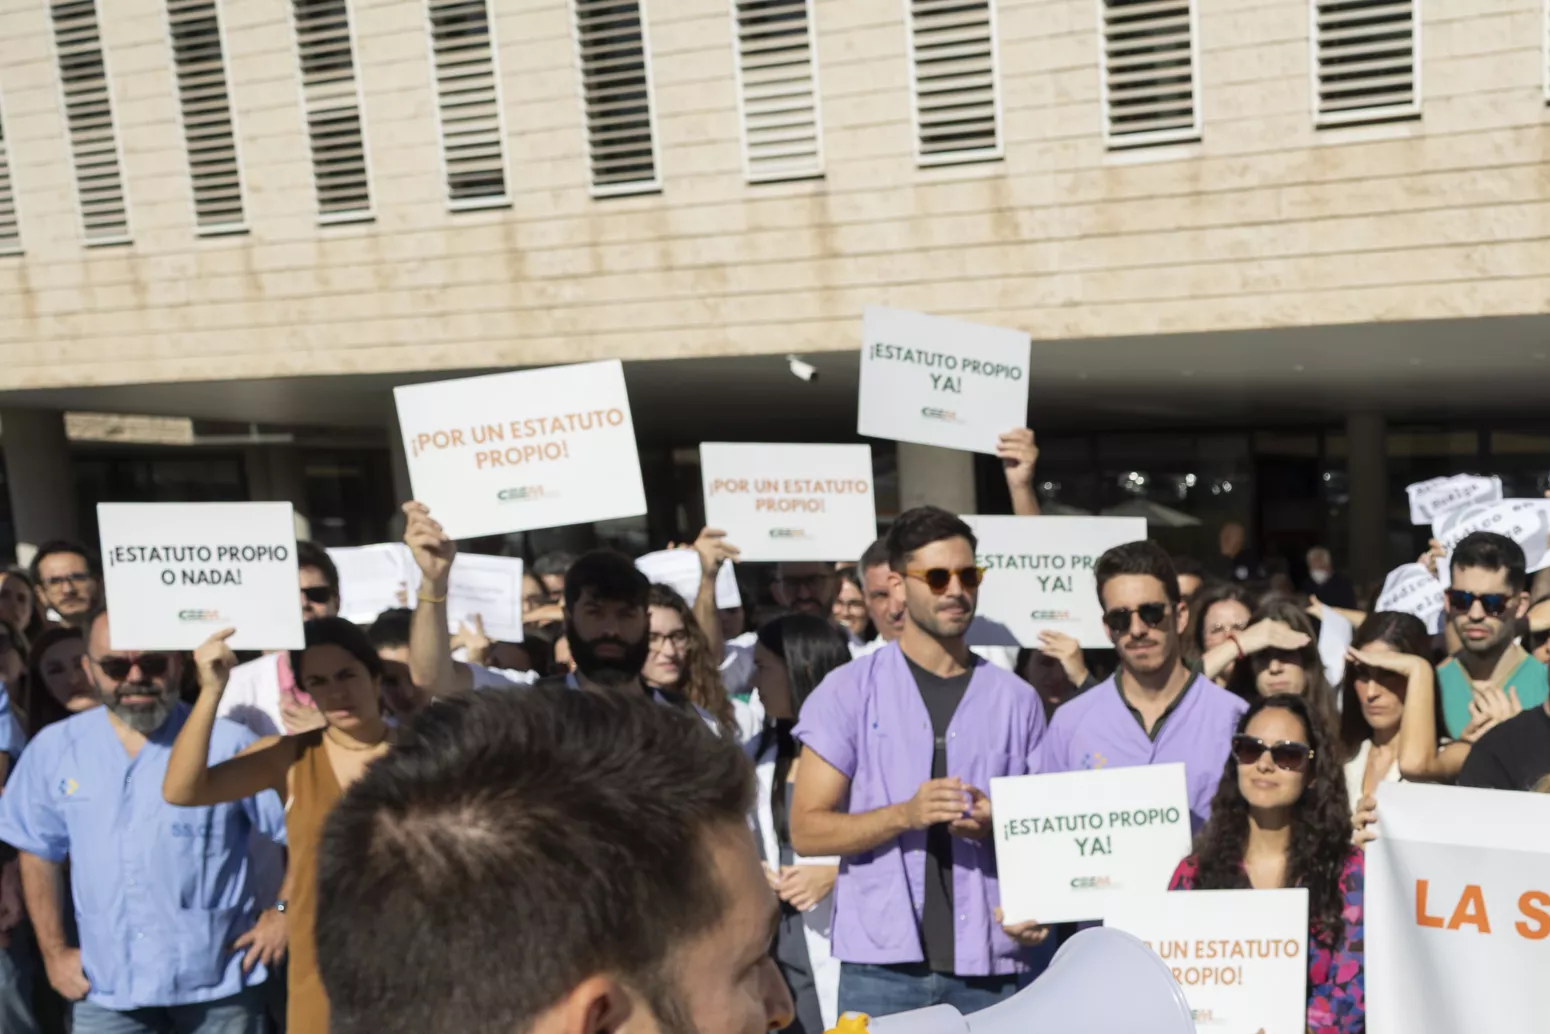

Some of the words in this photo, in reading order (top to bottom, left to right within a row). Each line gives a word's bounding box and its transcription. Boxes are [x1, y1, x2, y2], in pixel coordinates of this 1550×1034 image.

[870, 343, 958, 370] ¡ESTATUTO
[961, 358, 1022, 381] PROPIO
[930, 373, 962, 393] YA!
[411, 429, 465, 458] ¡POR
[471, 423, 504, 445] UN
[510, 408, 624, 439] ESTATUTO
[475, 440, 569, 470] PROPIO!
[754, 479, 779, 493] UN
[784, 479, 868, 494] ESTATUTO
[755, 499, 825, 513] PROPIO!
[109, 546, 211, 566] ¡ESTATUTO
[217, 545, 288, 561] PROPIO
[161, 569, 175, 585] O
[182, 569, 242, 585] NADA!
[1037, 576, 1073, 592] YA!
[1003, 813, 1103, 841] ¡ESTATUTO
[1109, 807, 1180, 828] PROPIO
[1074, 836, 1112, 856] YA!
[1414, 879, 1491, 934] LA
[1159, 940, 1188, 959] UN
[1195, 940, 1299, 958] ESTATUTO
[1171, 966, 1243, 985] ROPIO!
